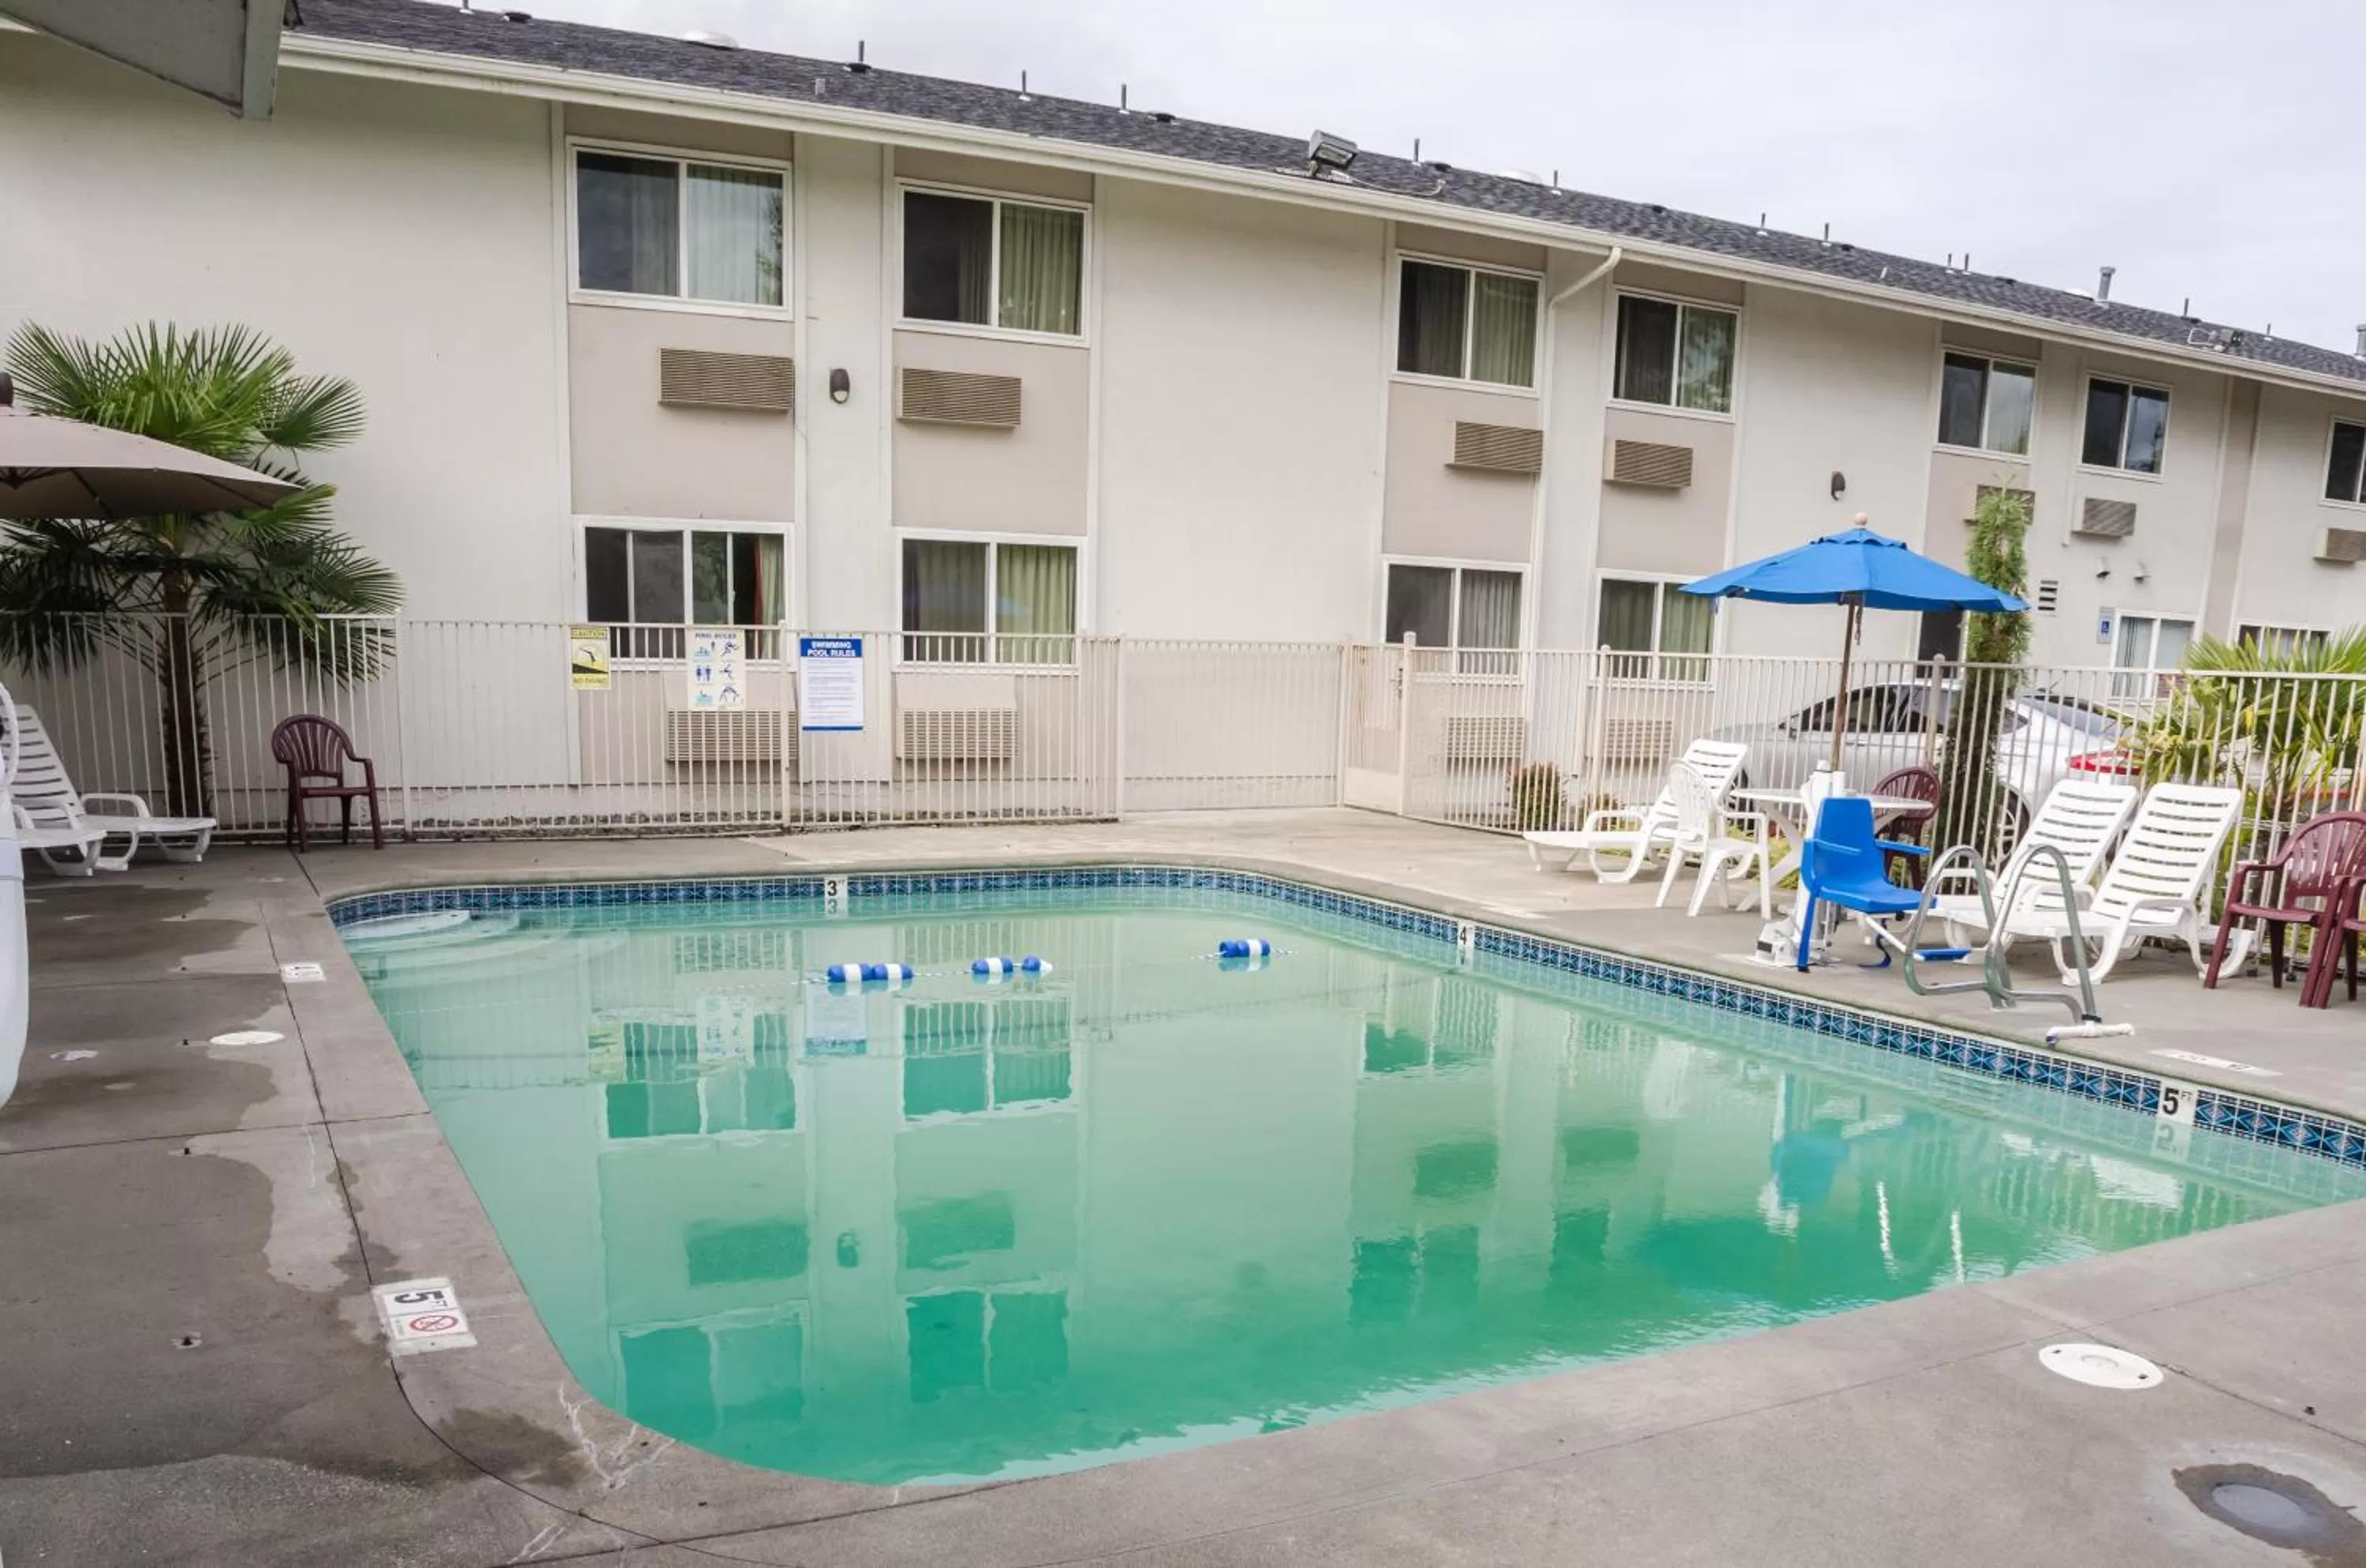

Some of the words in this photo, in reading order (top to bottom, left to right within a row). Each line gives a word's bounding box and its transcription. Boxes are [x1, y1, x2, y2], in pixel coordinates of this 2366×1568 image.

[812, 640, 852, 649] SWIMMING
[827, 880, 837, 896] 3
[1460, 926, 1467, 946] 4
[2163, 1088, 2179, 1115] 5
[2181, 1091, 2193, 1102] FT
[394, 1290, 444, 1303] 5
